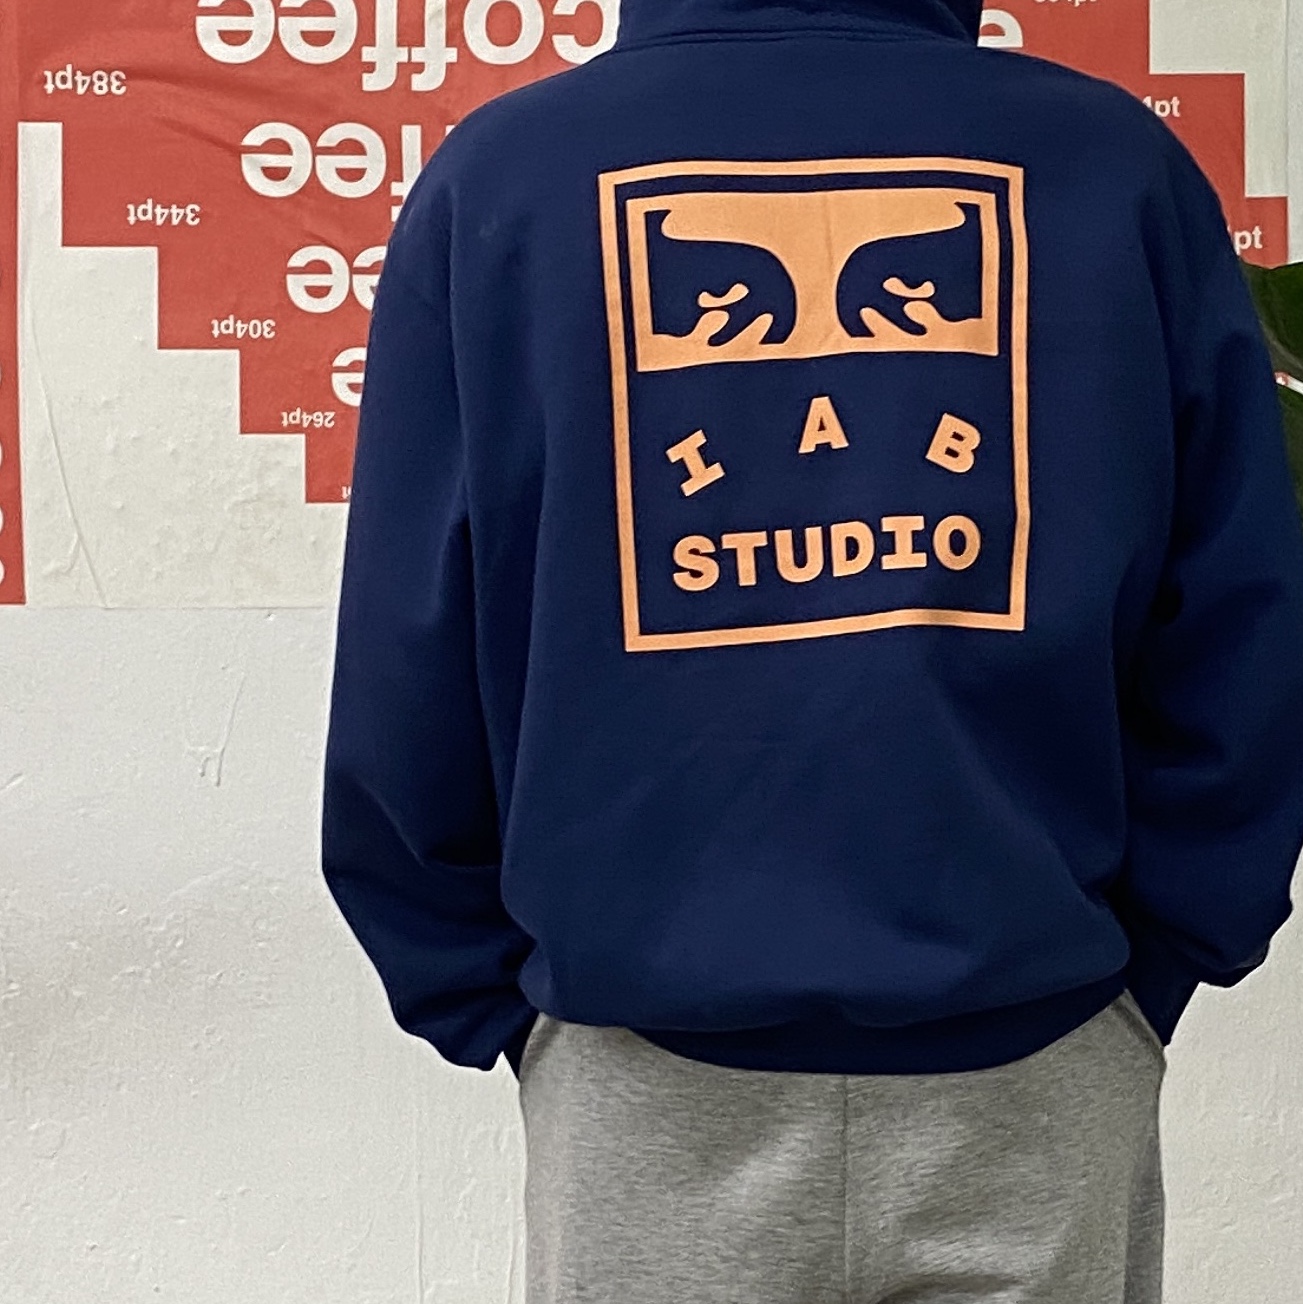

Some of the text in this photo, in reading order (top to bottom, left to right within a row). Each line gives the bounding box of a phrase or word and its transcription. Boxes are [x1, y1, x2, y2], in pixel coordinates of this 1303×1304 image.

[196, 0, 620, 91] coffee
[44, 64, 127, 95] 384pt
[127, 199, 201, 226] 344pt
[211, 315, 275, 339] 304pt
[281, 408, 335, 428] 264pt
[673, 515, 981, 592] STUDIO
